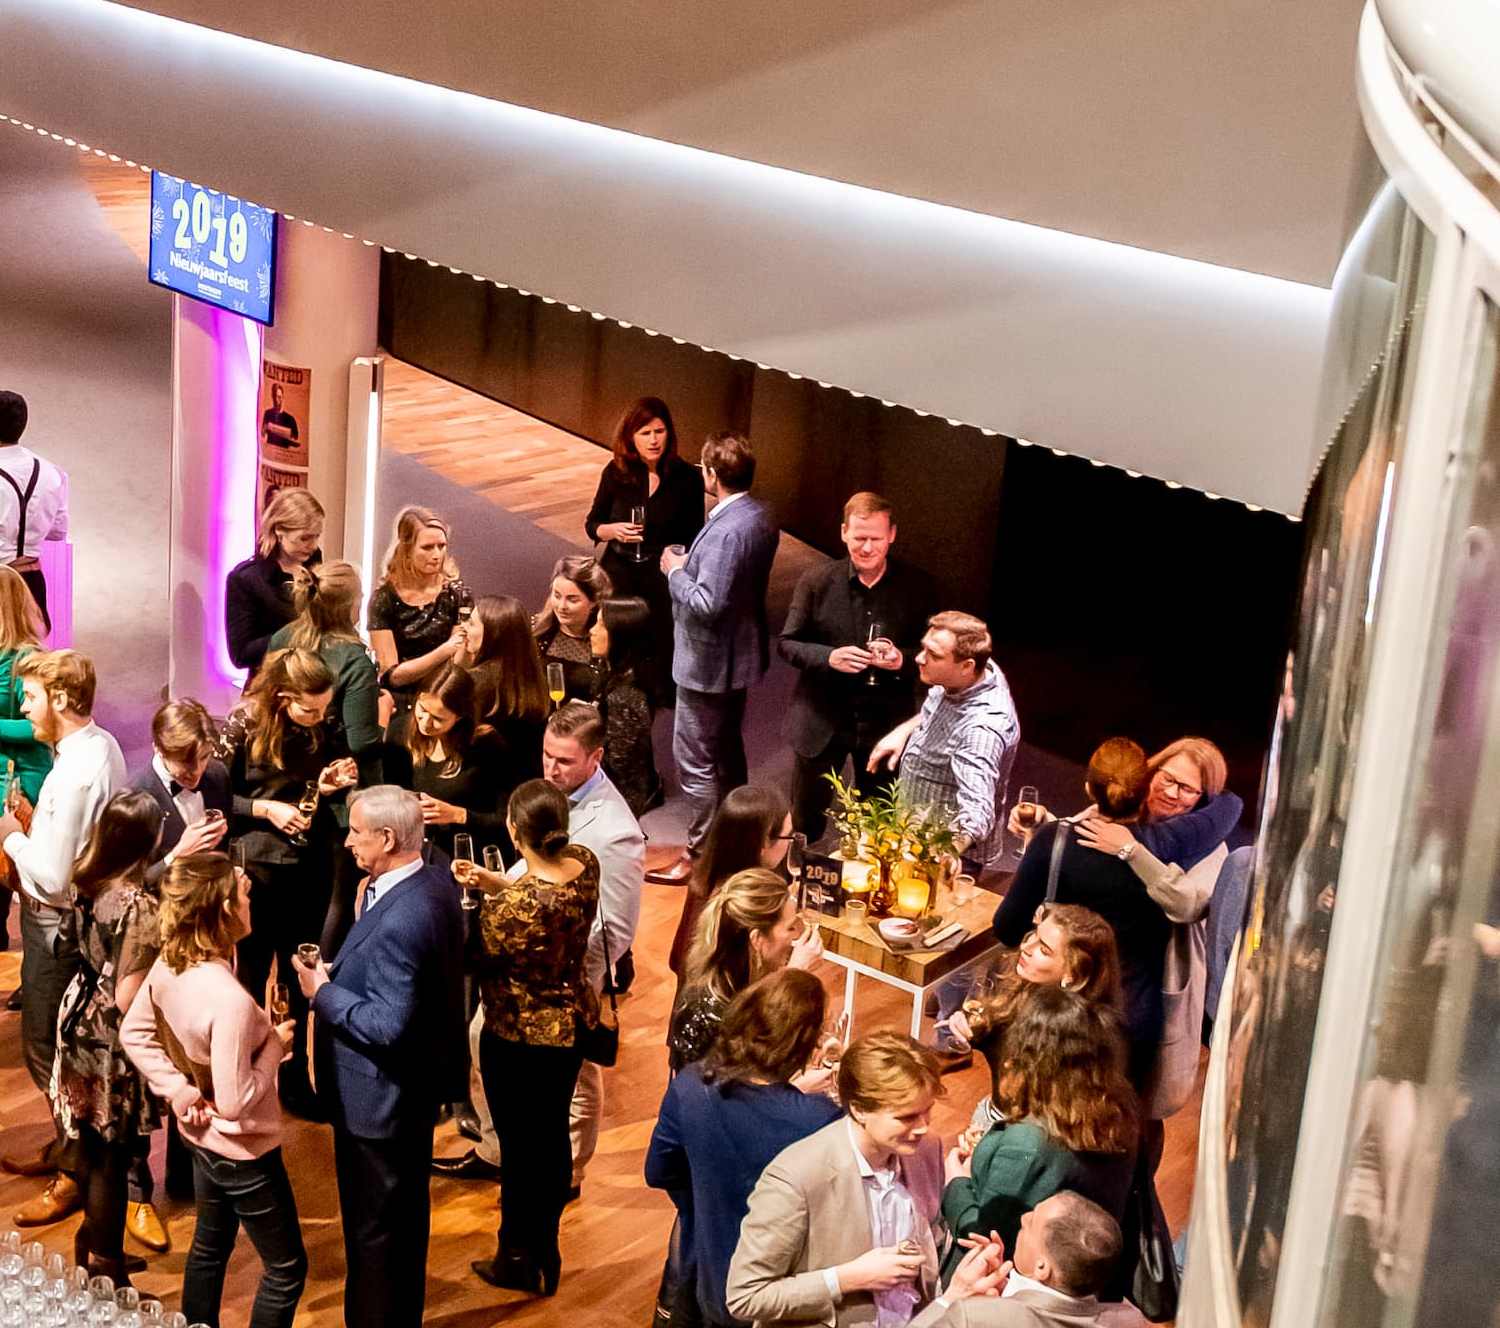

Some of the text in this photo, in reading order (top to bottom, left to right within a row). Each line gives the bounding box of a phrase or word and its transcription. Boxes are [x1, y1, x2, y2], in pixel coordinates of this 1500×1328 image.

[172, 190, 247, 269] 2019
[169, 250, 250, 292] Nieuwjaarsfeest
[805, 864, 838, 886] 2019
